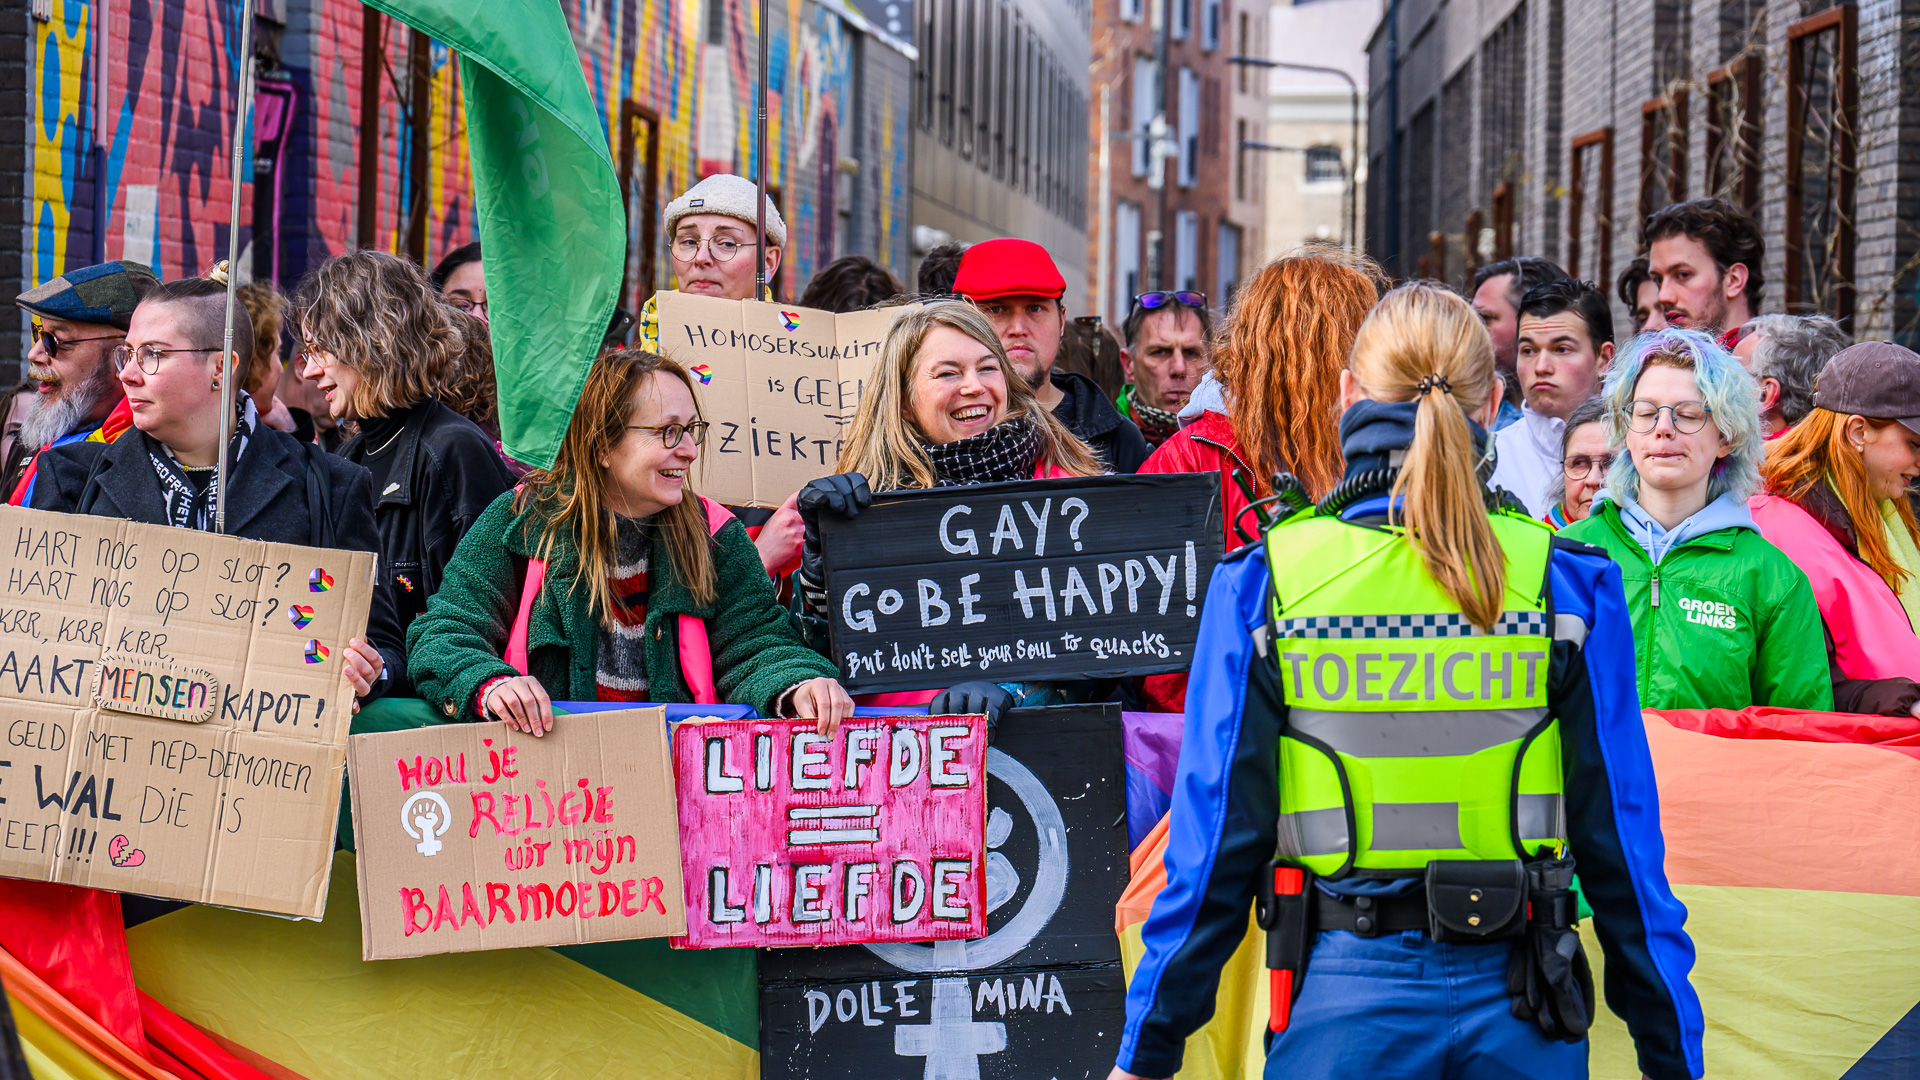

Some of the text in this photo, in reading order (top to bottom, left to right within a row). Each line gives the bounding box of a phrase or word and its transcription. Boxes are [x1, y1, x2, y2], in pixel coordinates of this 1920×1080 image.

[794, 376, 864, 409] GEE
[939, 497, 1089, 557] GAY?
[14, 527, 82, 568] HART
[162, 549, 200, 590] OP
[218, 558, 291, 588] SLOT?
[917, 572, 987, 628] BE
[1012, 540, 1197, 622] HAPPY!
[8, 567, 77, 600] HART
[156, 587, 189, 626] OP
[210, 593, 279, 627] SLOT?
[1678, 597, 1737, 616] GROEN
[1686, 610, 1737, 630] LINKS
[1282, 651, 1546, 701] TOEZICHT
[221, 683, 326, 733] KAPOT!
[8, 720, 66, 751] GELD
[85, 731, 134, 762] MET
[705, 725, 971, 793] LIEFDE
[34, 764, 122, 822] WAL
[394, 752, 467, 793] HOU
[0, 817, 98, 864] EEN!!!
[709, 859, 971, 925] LIEFDE
[804, 973, 1073, 1034] DOLLE MINA
